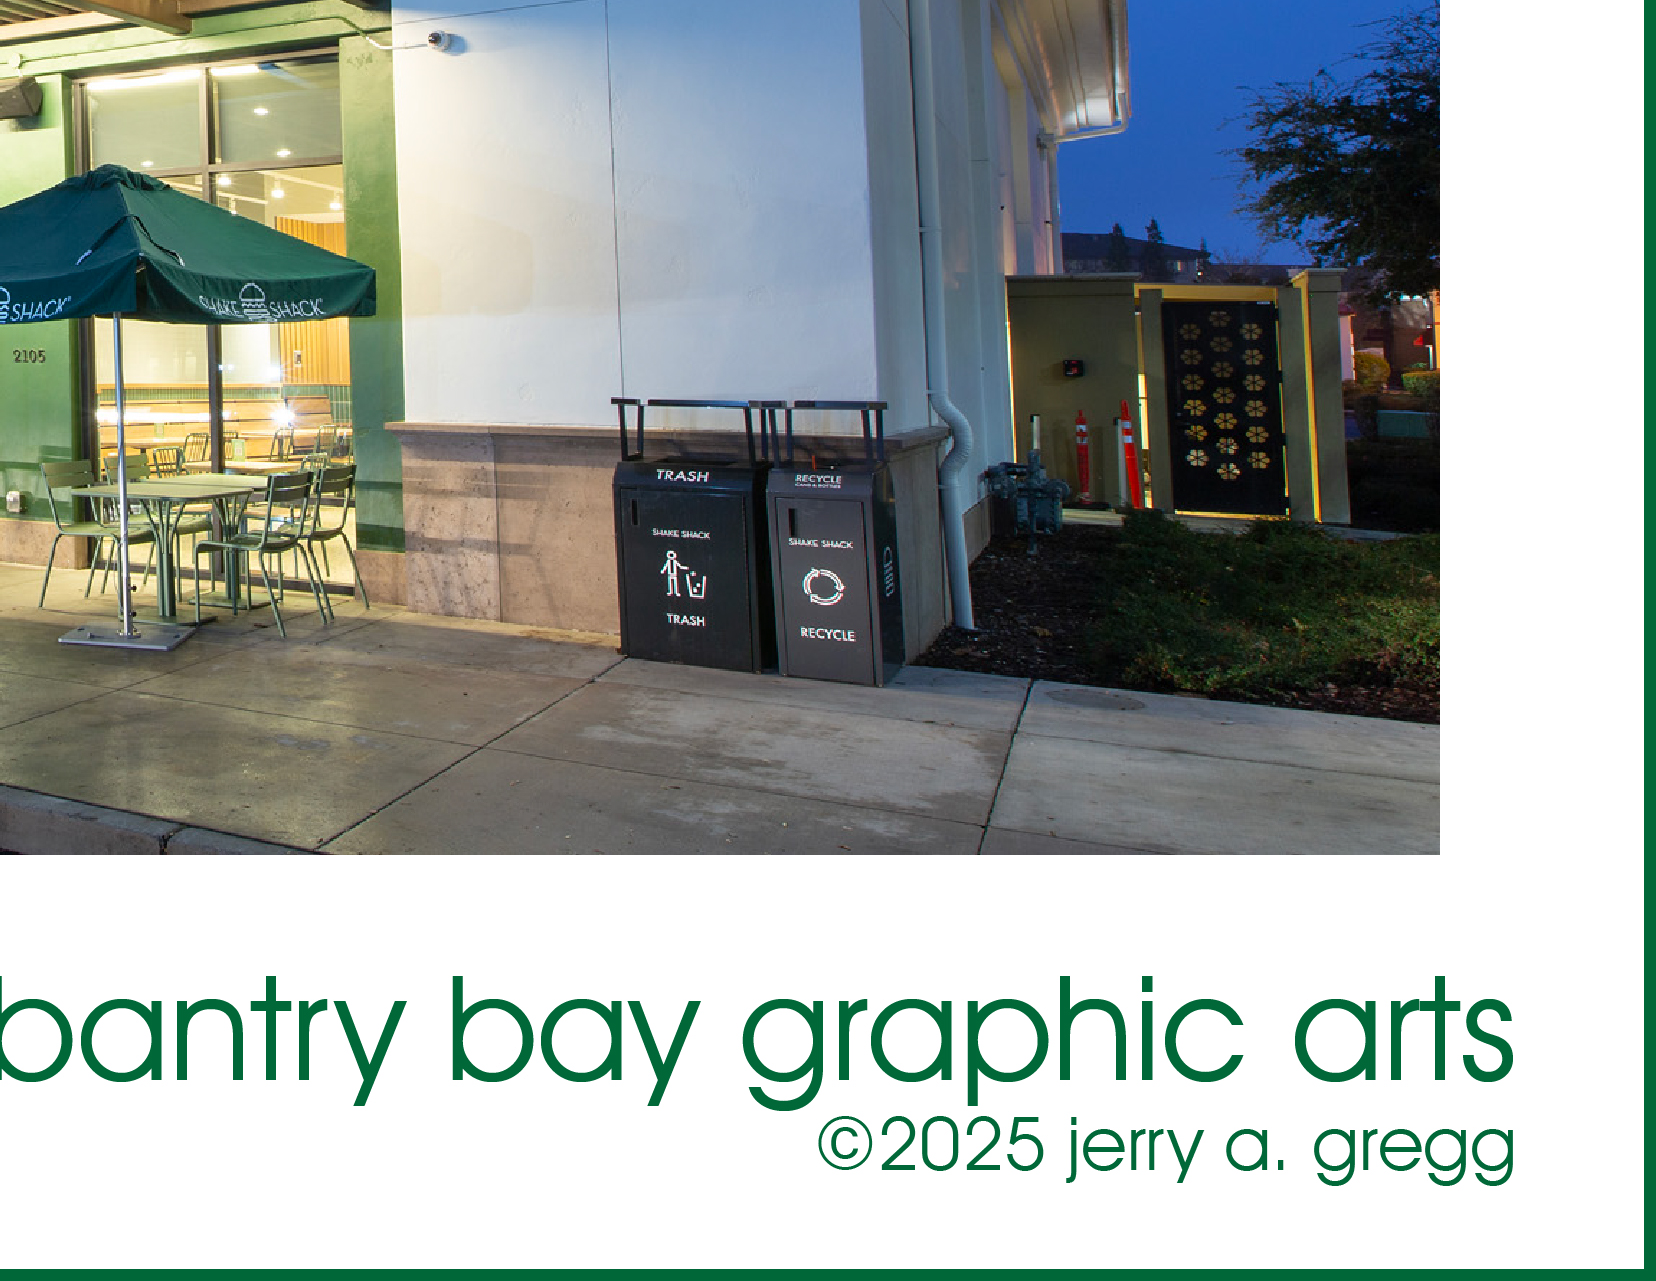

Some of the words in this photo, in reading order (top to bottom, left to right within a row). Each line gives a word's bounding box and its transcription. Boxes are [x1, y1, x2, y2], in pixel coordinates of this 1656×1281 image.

[9, 297, 68, 322] SHACK
[269, 298, 326, 319] SHACK
[13, 349, 46, 364] 2105
[656, 468, 710, 483] TRASH
[794, 474, 842, 484] RECYCLE
[651, 527, 680, 538] SHAKE
[680, 530, 711, 540] SHACK
[788, 537, 819, 548] SHAKE
[820, 539, 854, 550] SHACK
[666, 612, 707, 628] TRASH
[800, 626, 857, 643] RECYCLE
